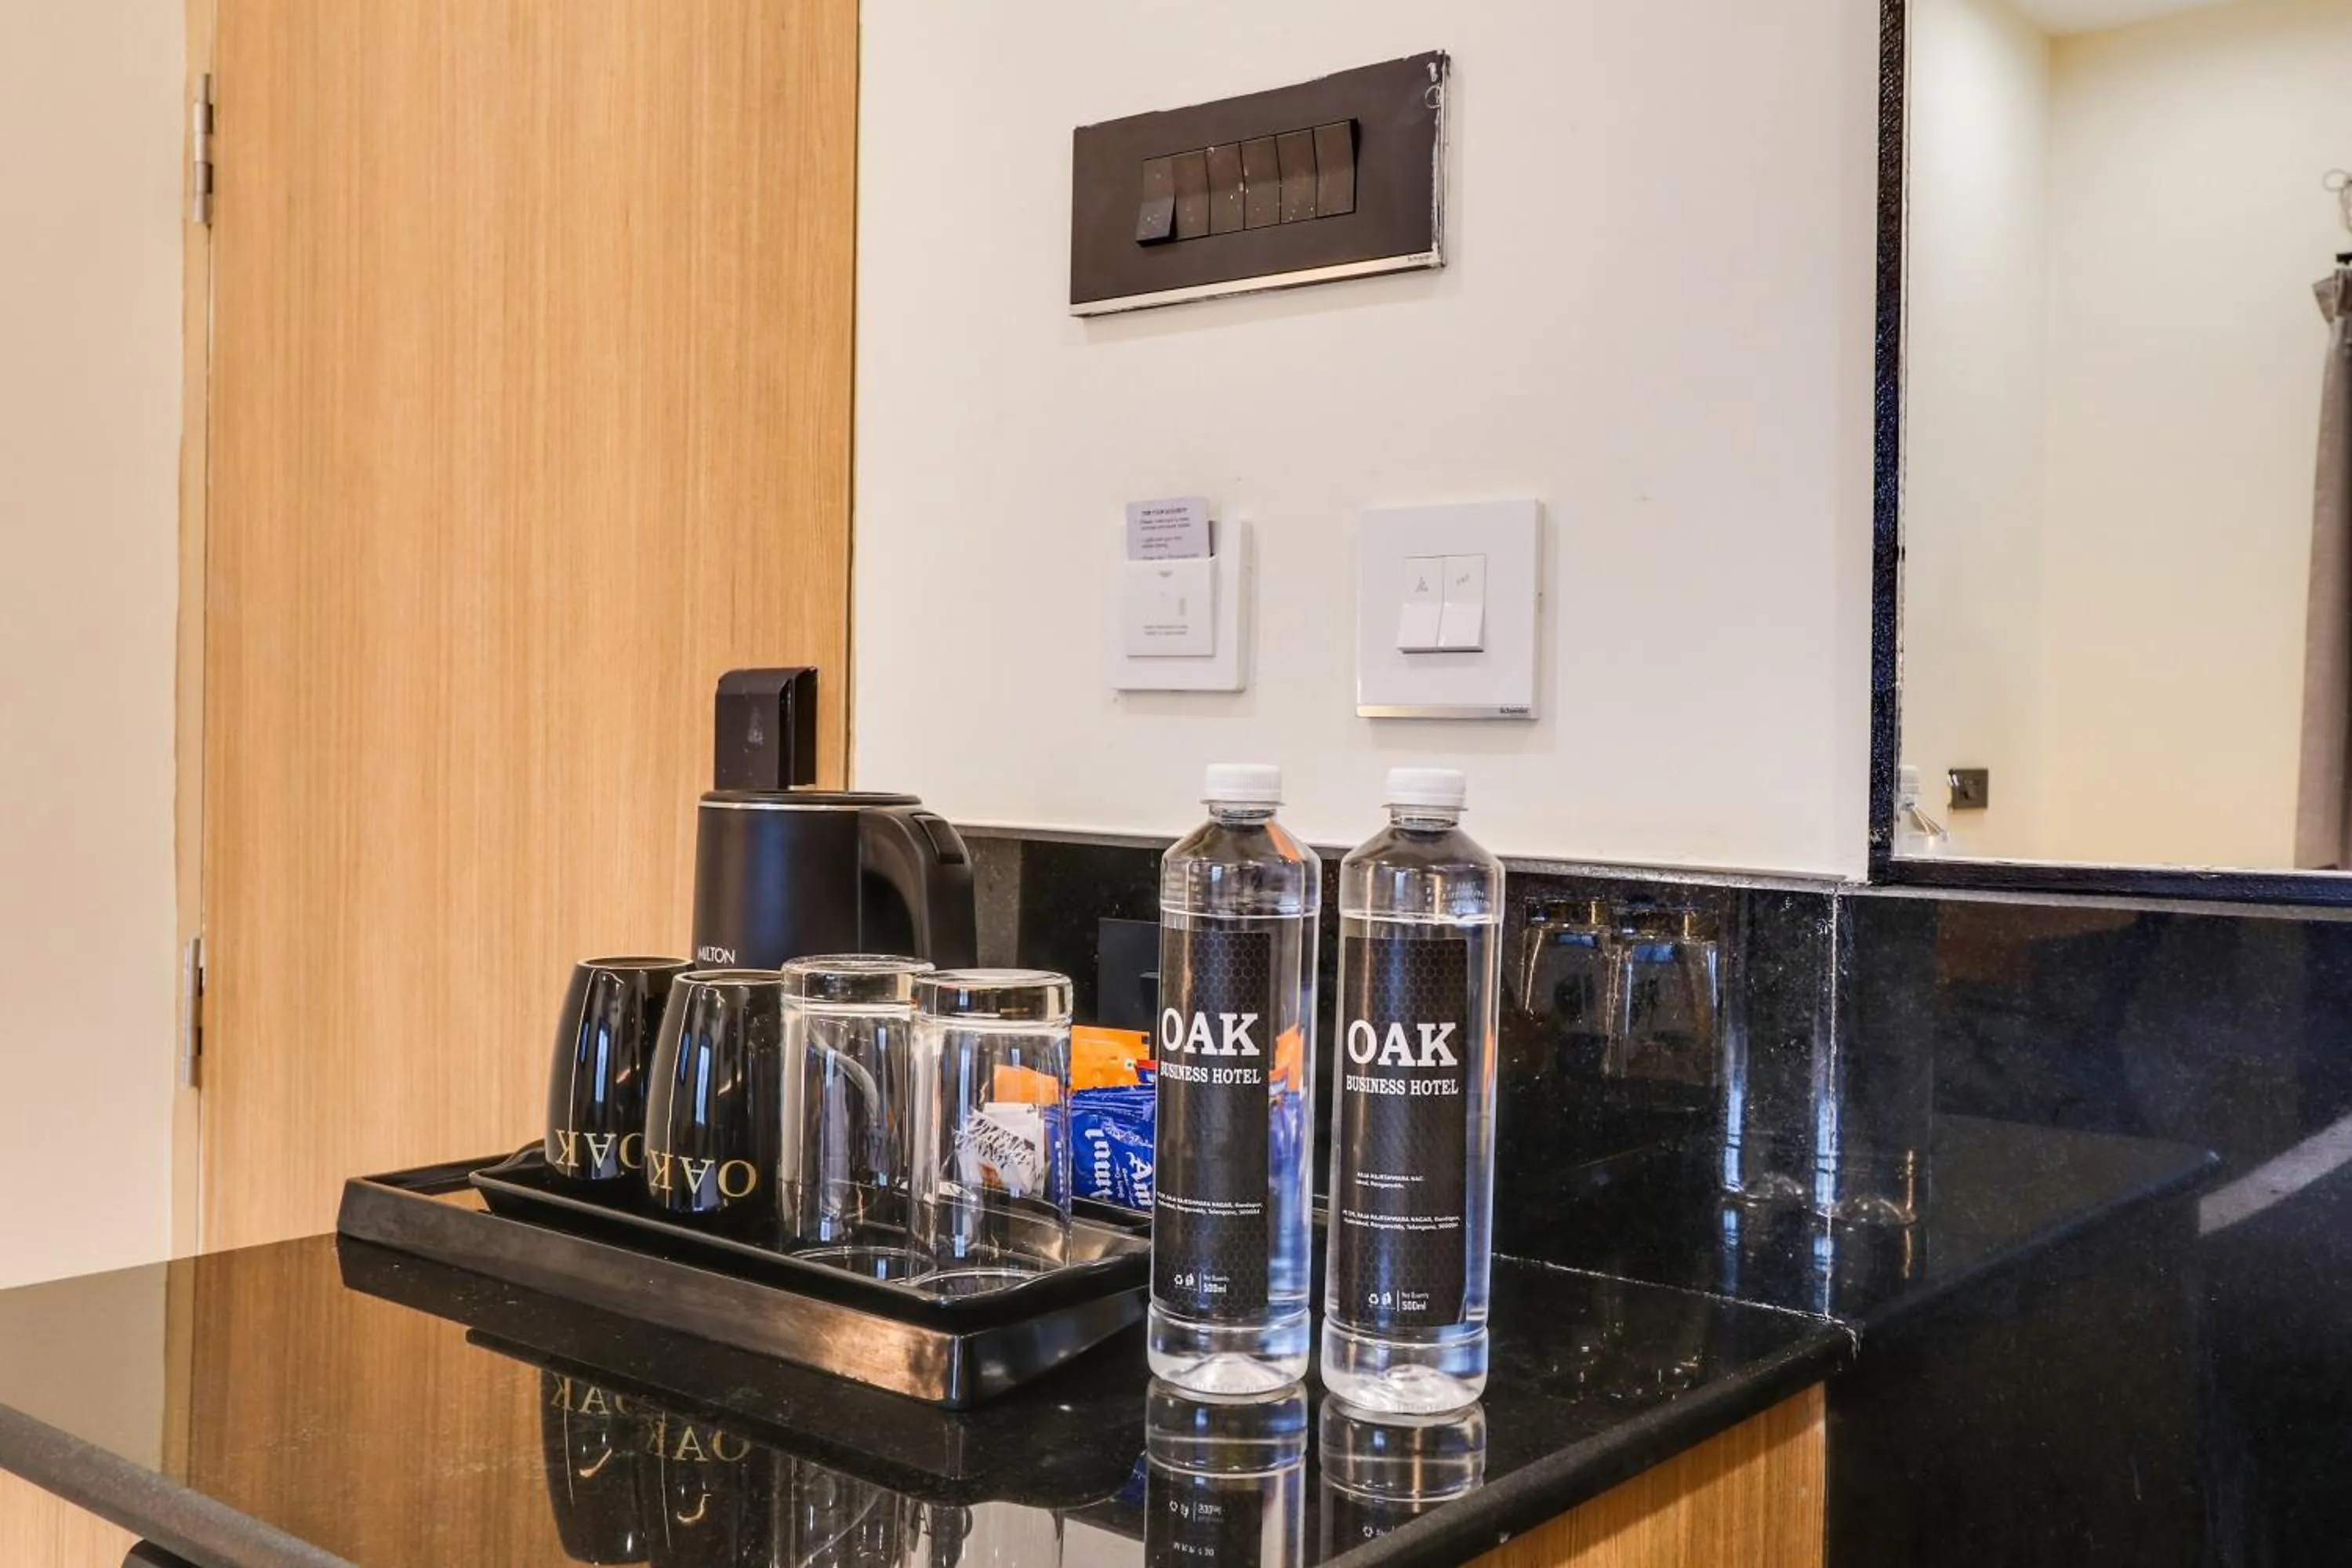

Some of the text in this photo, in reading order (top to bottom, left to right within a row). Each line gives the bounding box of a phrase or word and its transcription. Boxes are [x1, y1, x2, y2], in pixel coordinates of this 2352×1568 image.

[697, 946, 735, 964] MILTON
[1161, 1007, 1260, 1056] OAK
[1348, 1019, 1457, 1067] OAK
[1160, 1061, 1208, 1083] BUSINESS
[1212, 1068, 1261, 1084] HOTEL
[1346, 1075, 1459, 1095] BUSINESS HOTEL
[648, 1149, 757, 1197] OAK
[1401, 1301, 1427, 1311] 500ml
